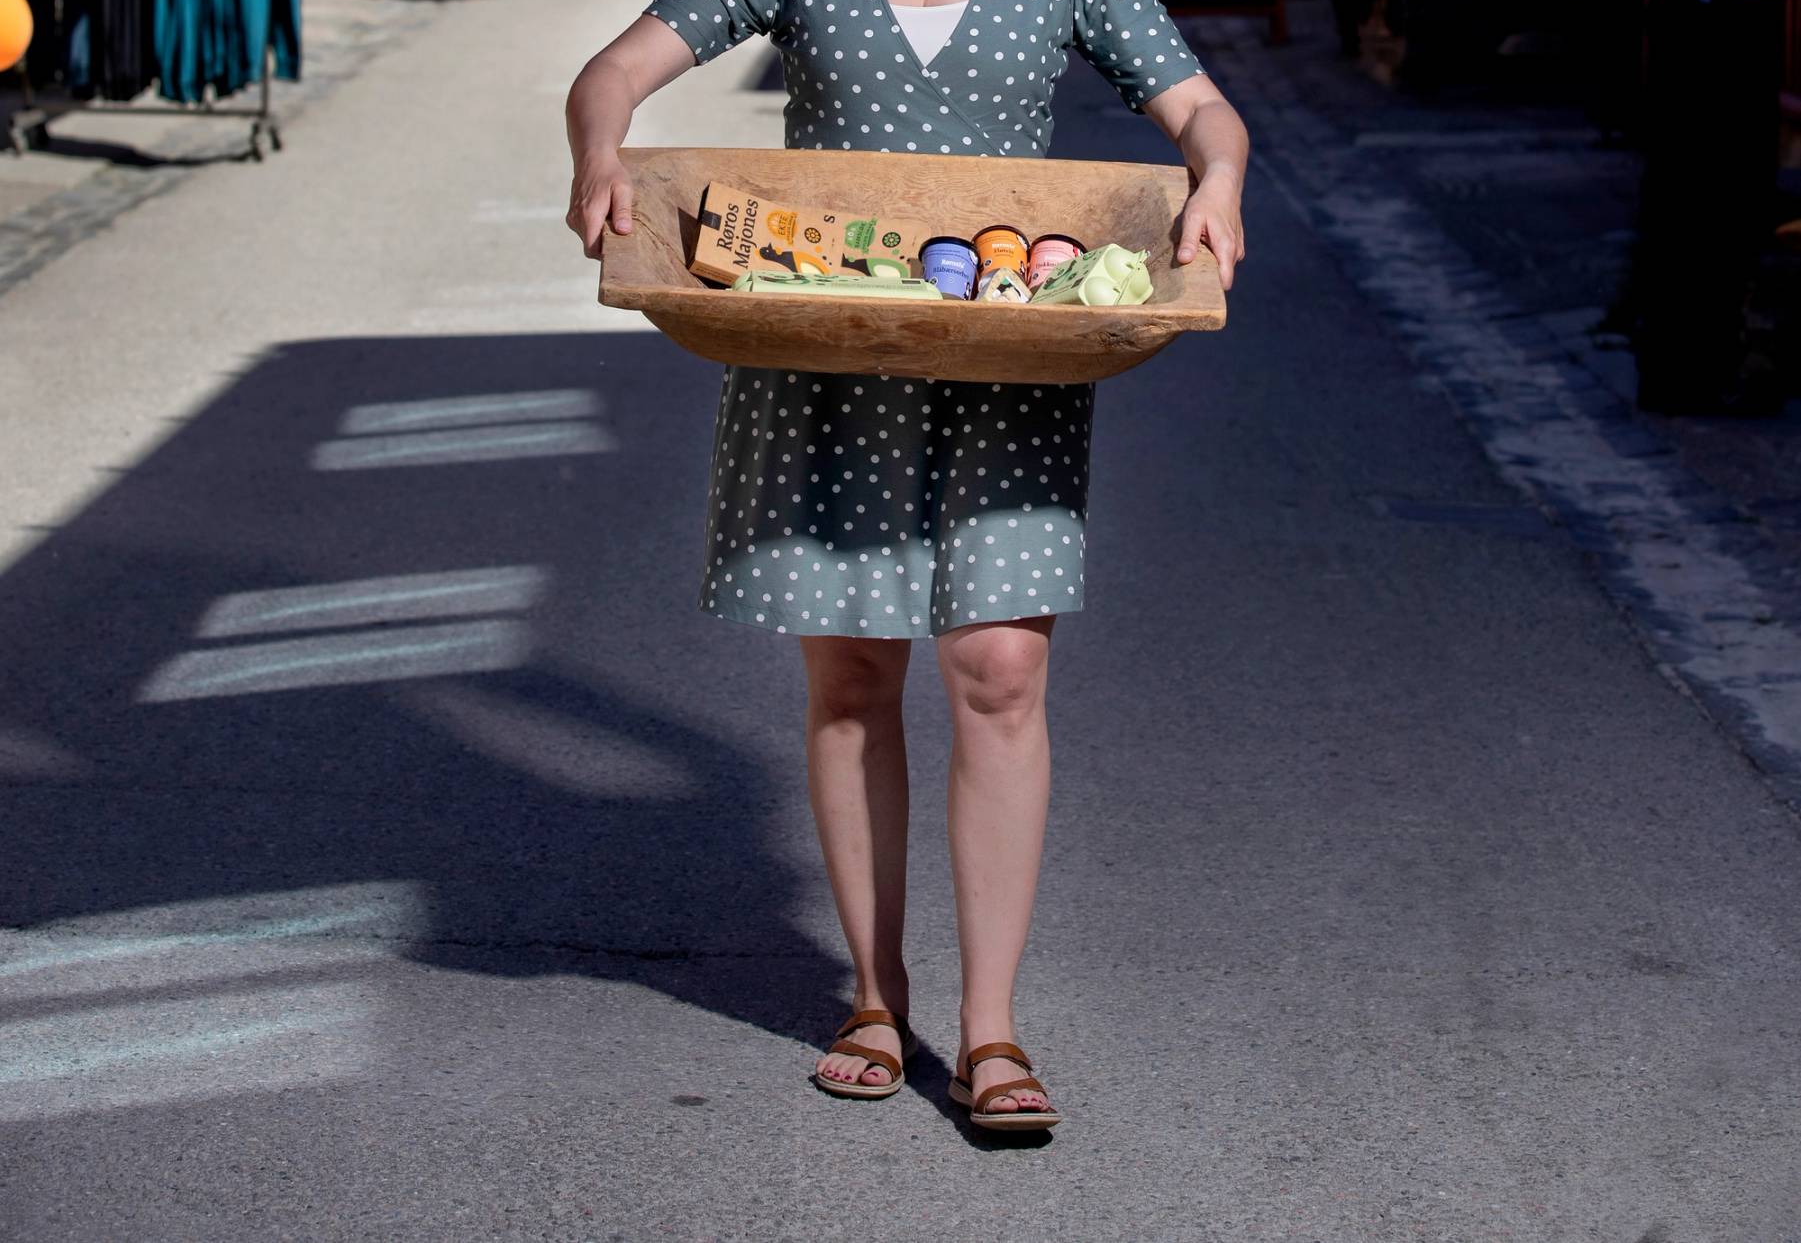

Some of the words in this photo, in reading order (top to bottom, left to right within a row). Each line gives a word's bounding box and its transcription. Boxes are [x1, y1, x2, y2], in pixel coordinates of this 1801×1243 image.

[716, 203, 739, 252] Røros
[732, 199, 759, 270] Majones
[778, 214, 788, 236] EKTE
